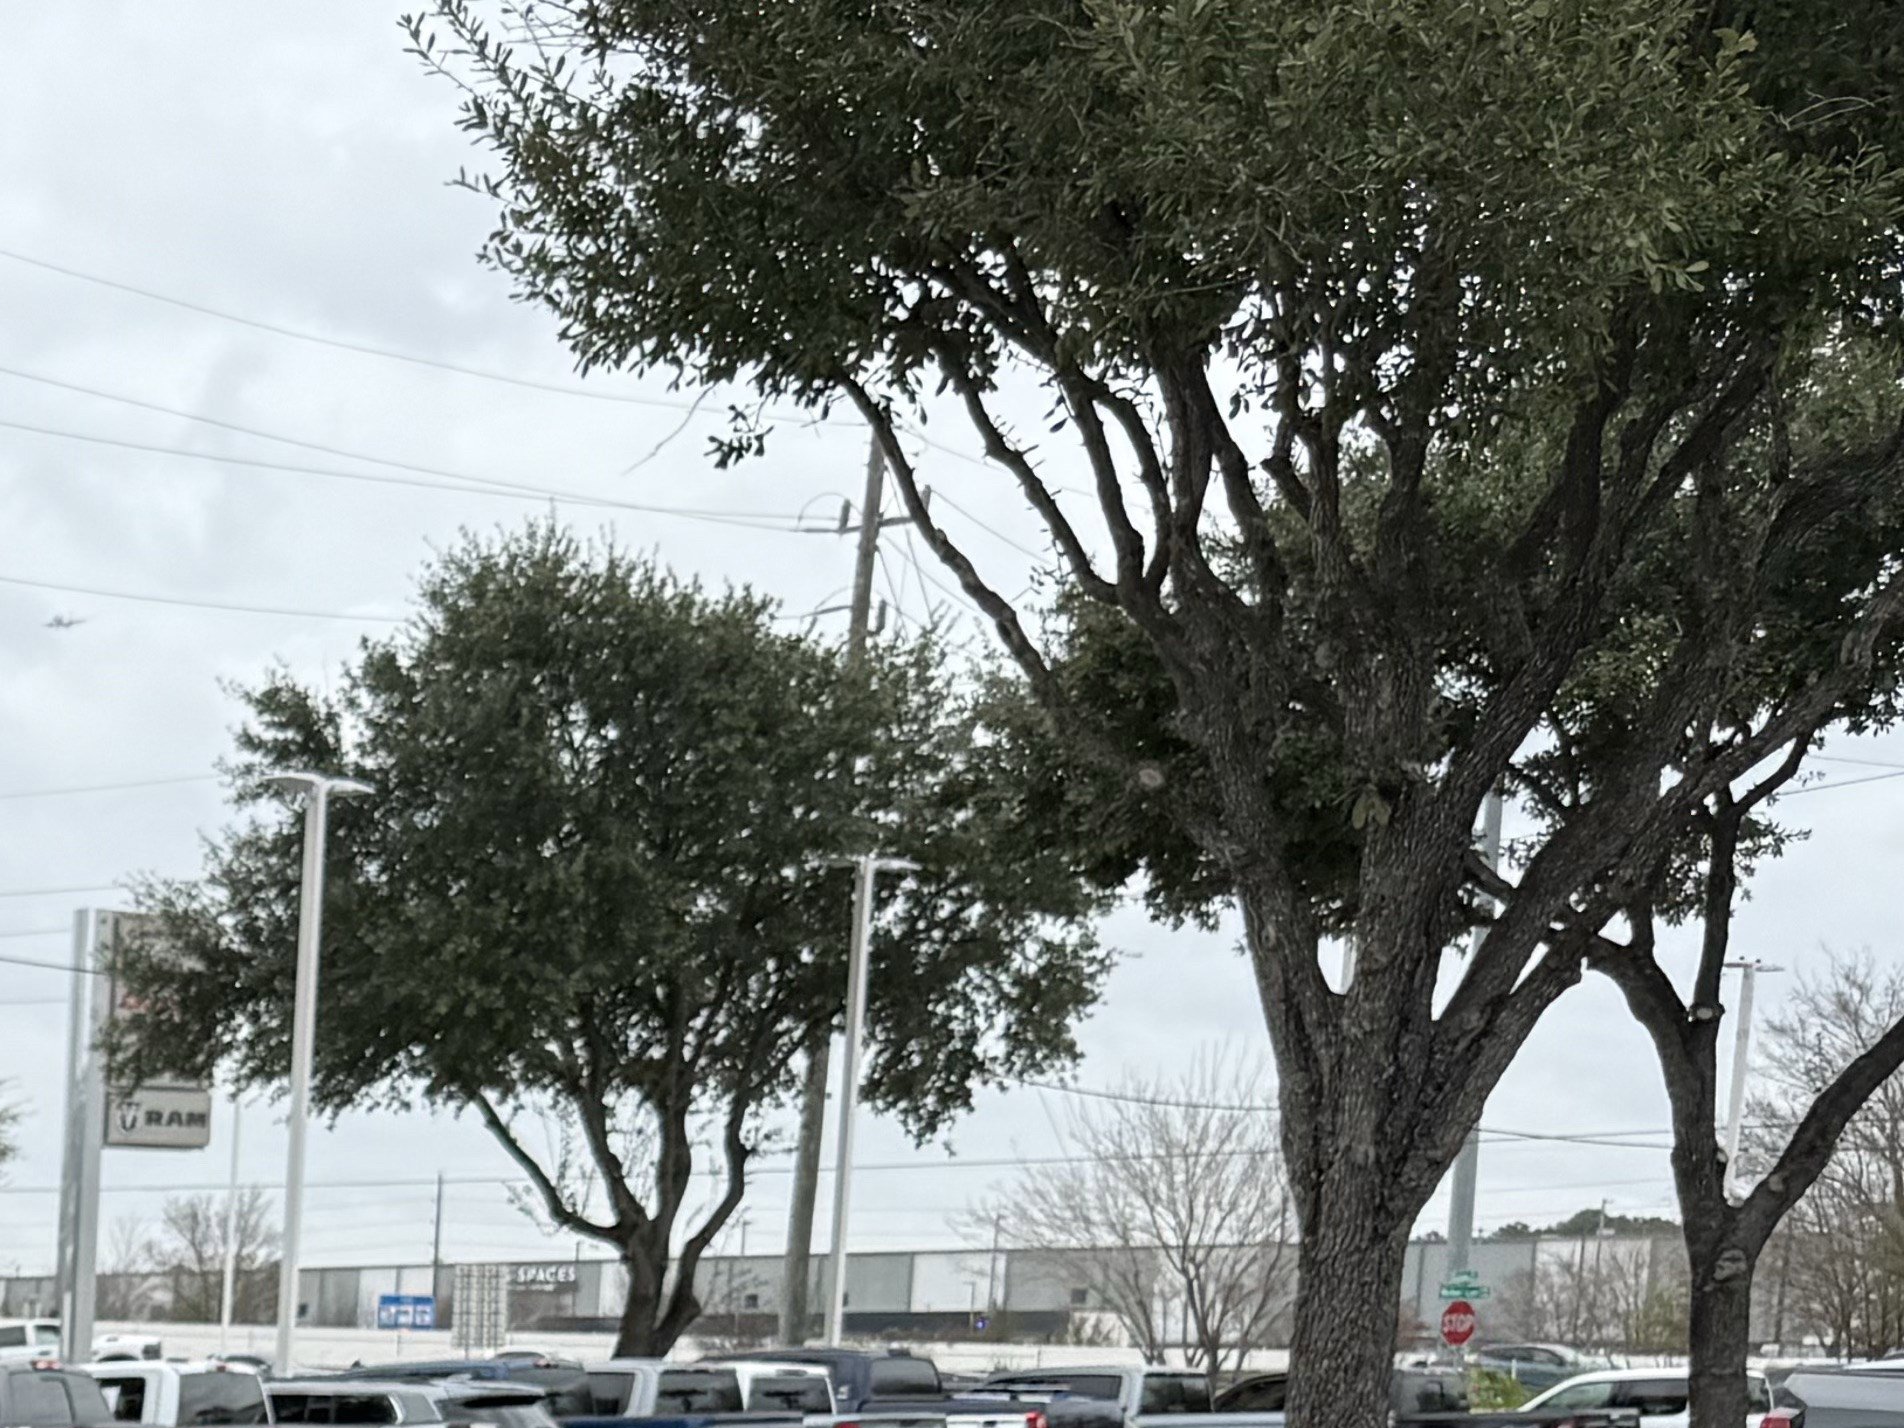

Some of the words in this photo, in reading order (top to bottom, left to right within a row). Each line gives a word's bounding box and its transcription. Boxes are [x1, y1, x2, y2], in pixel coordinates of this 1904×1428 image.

[144, 1110, 207, 1129] RAM
[517, 1265, 576, 1282] SPACES
[1443, 1313, 1475, 1333] STOP
